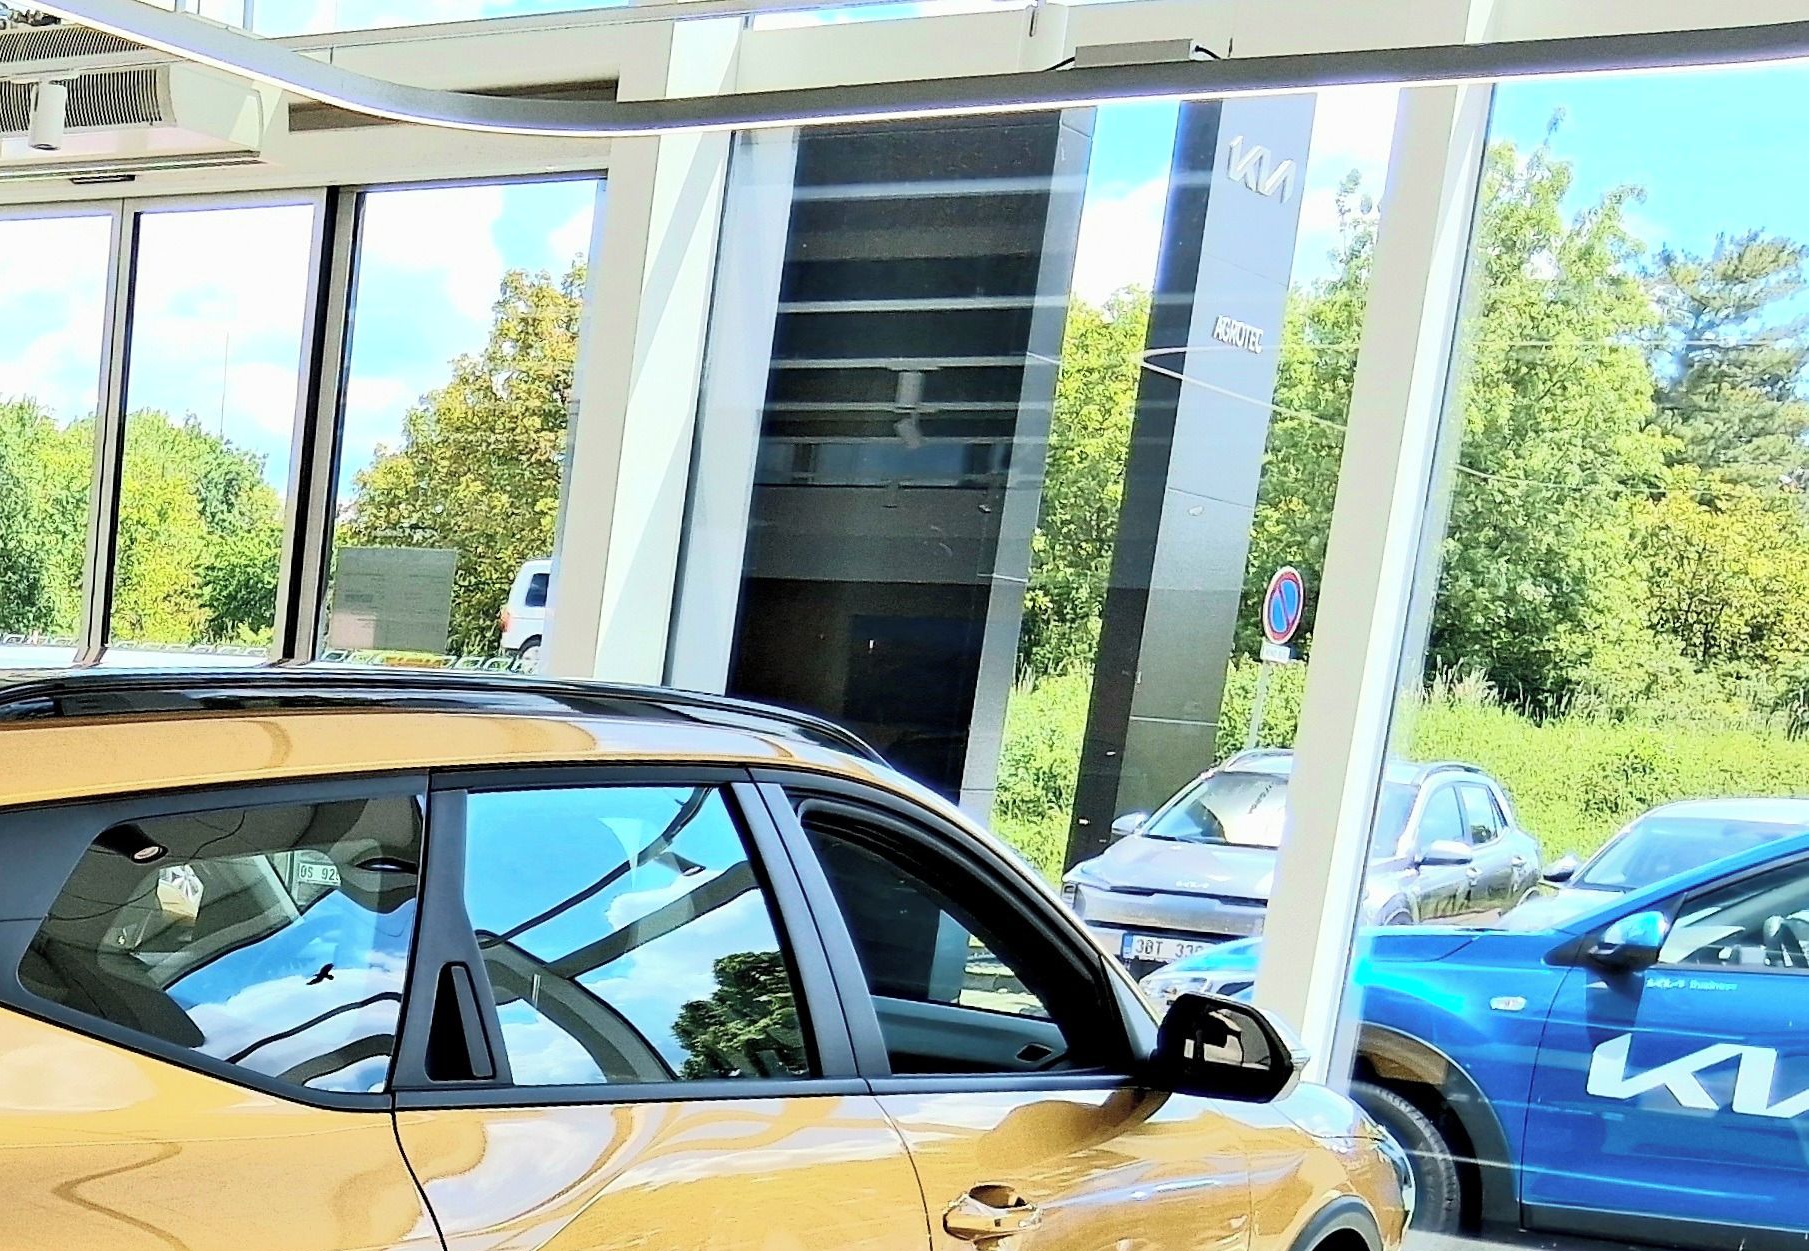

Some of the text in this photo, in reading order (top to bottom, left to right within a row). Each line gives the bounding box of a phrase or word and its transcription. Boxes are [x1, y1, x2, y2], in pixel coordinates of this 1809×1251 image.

[1227, 135, 1296, 204] KIA
[1212, 314, 1263, 354] AGROTEC
[1586, 1032, 1809, 1119] KI
